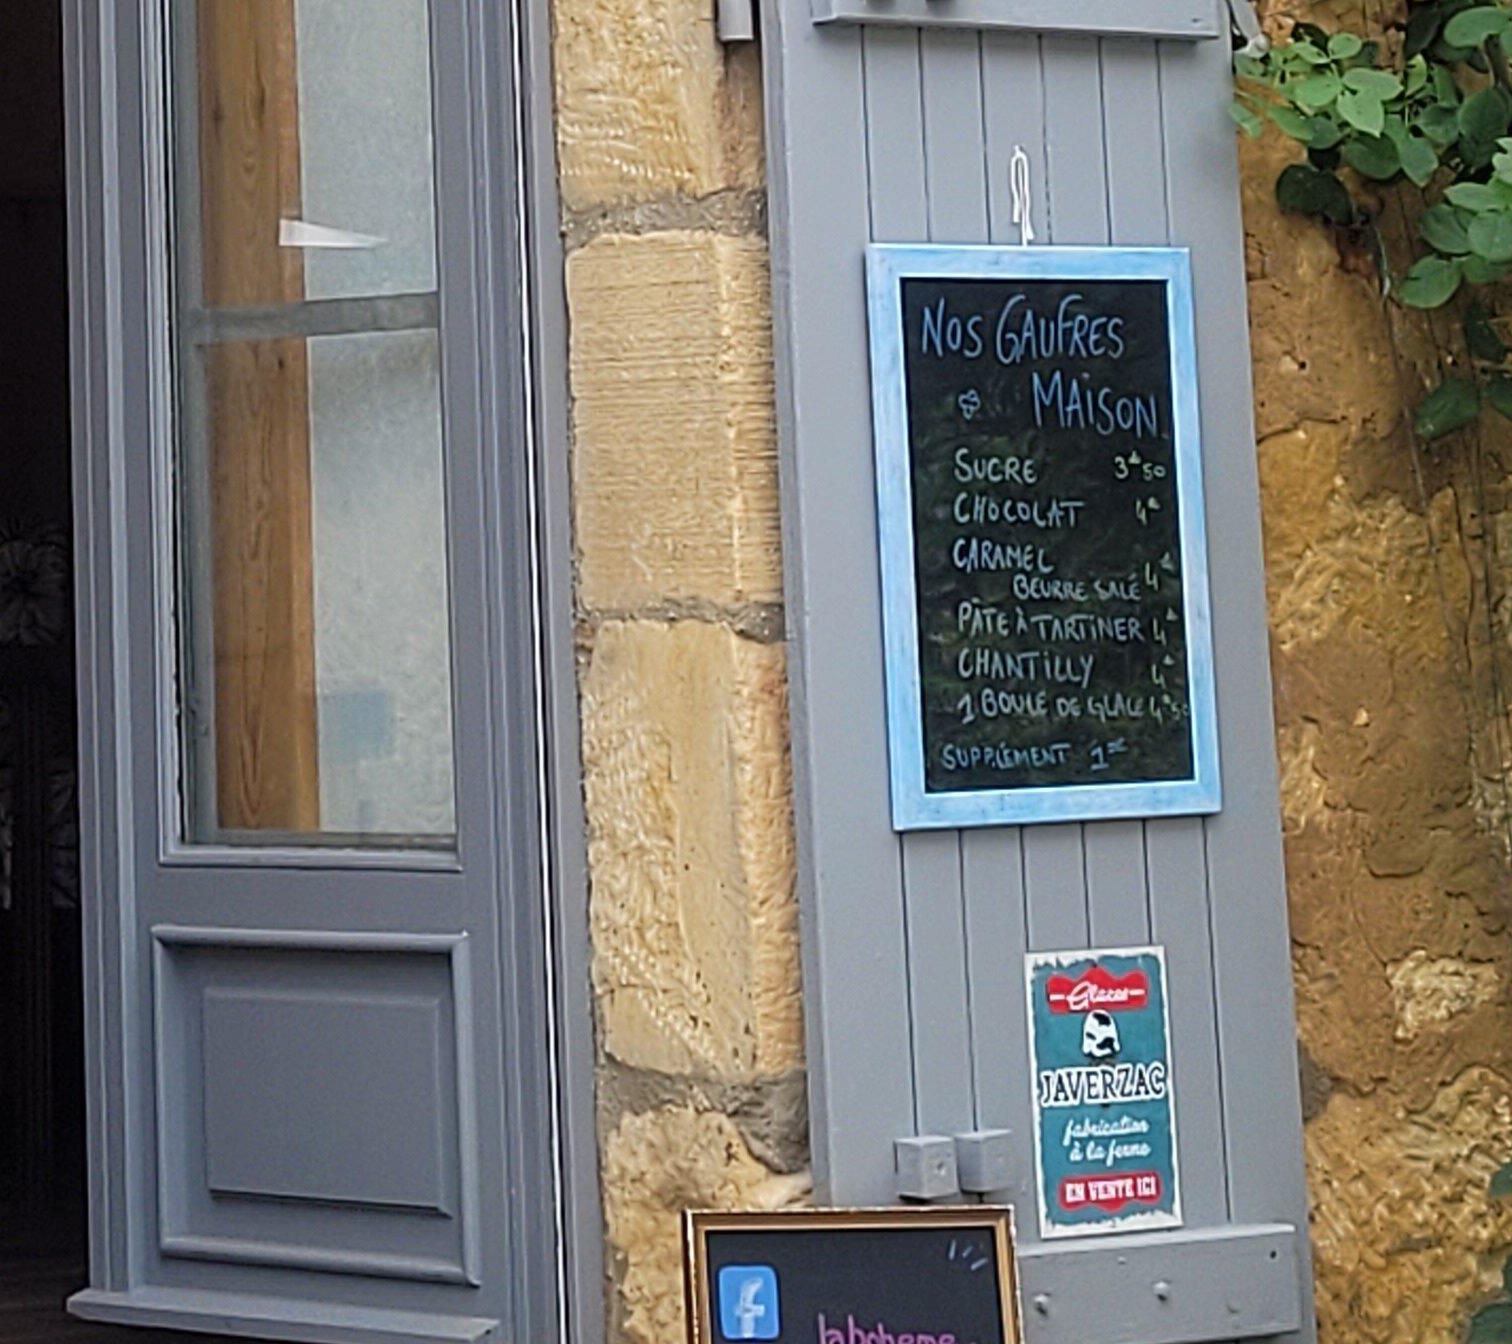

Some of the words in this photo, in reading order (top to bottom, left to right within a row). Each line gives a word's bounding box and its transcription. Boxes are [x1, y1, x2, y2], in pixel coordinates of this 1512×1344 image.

[996, 294, 1125, 364] GAUFRES
[954, 447, 1039, 485] SUCRE
[953, 492, 1086, 528] CHOCOLAT
[953, 538, 1055, 575] CARAMEL
[1013, 573, 1087, 601] BEURRE
[1094, 573, 1142, 602] SALÉ
[981, 687, 1048, 718] BOULE
[1057, 696, 1081, 717] DE
[1042, 1064, 1165, 1104] JAVERZAC
[1063, 1115, 1149, 1146] fabrication
[1087, 1141, 1105, 1160] la
[1106, 1139, 1151, 1167] ferme
[1065, 1183, 1085, 1202] EN
[1088, 1178, 1134, 1201] VENTE
[1137, 1176, 1157, 1196] ICI
